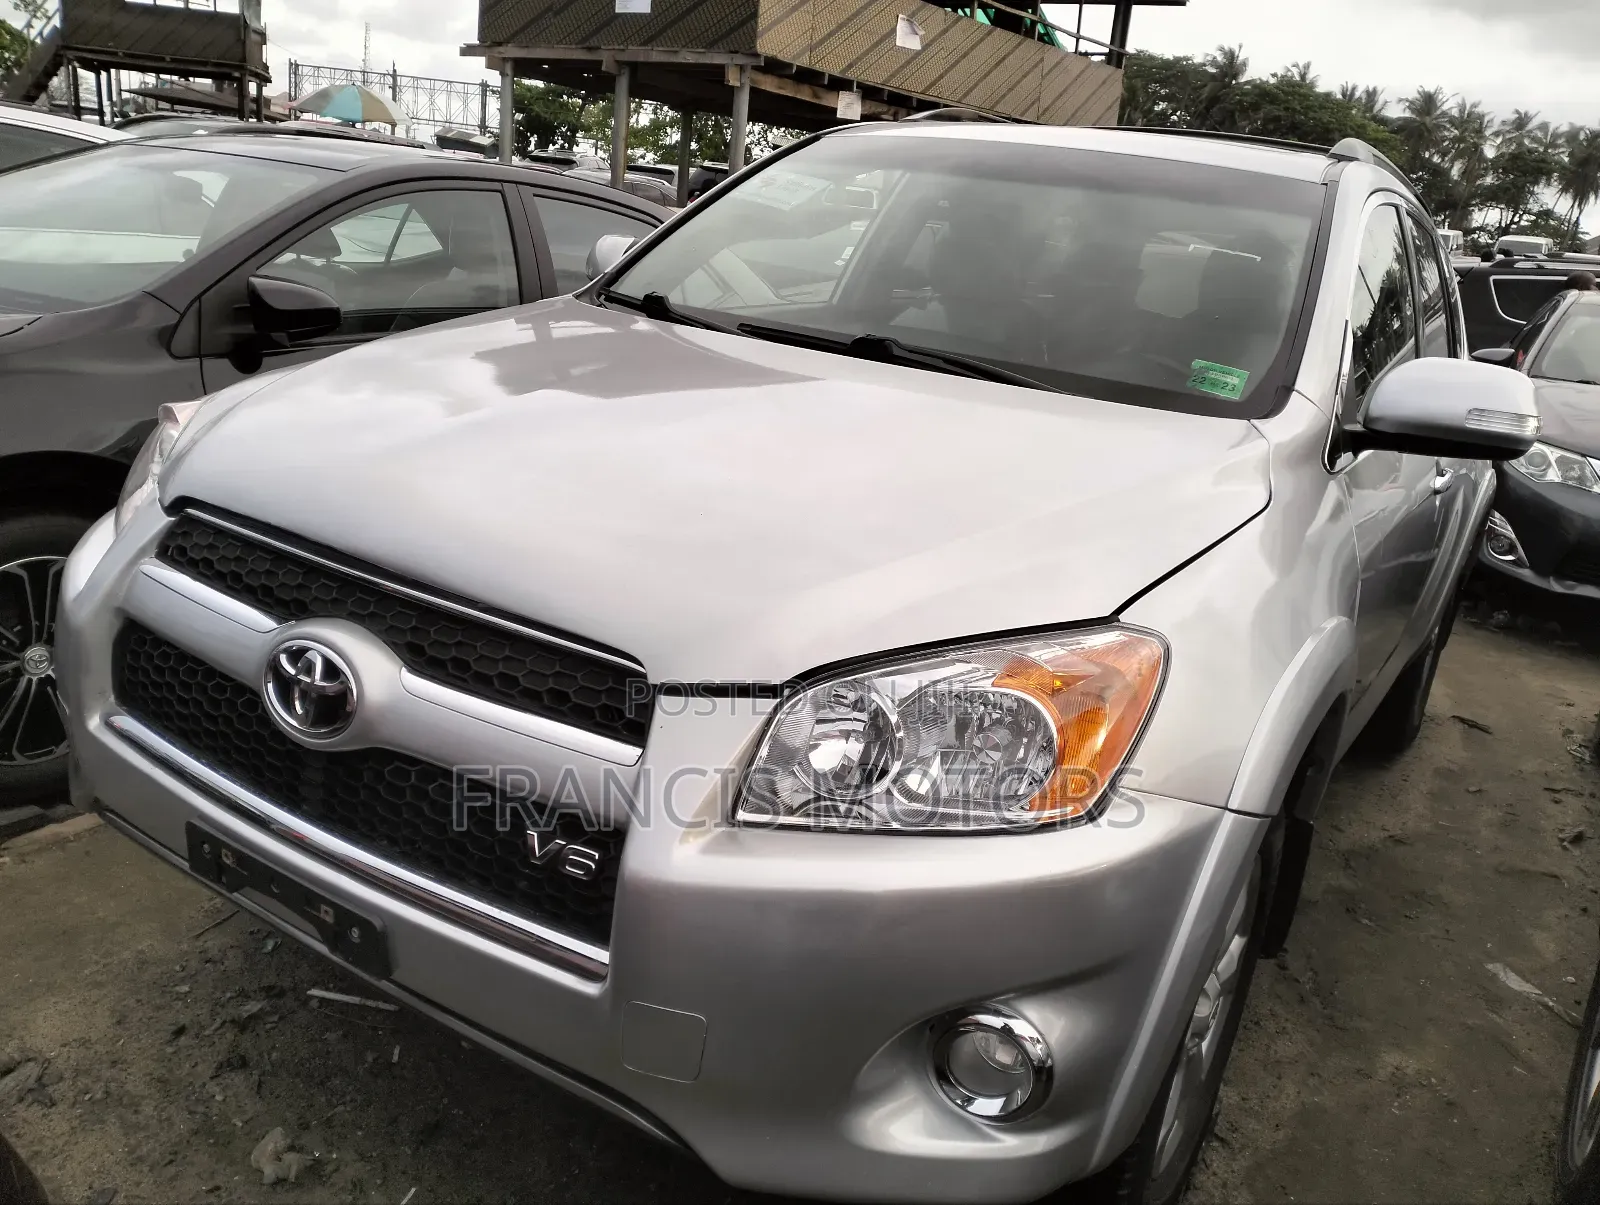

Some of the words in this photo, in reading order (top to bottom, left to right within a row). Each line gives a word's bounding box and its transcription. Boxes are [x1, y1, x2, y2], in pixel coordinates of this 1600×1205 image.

[1191, 374, 1207, 385] 22
[1220, 381, 1237, 392] 23
[526, 830, 599, 880] V6
